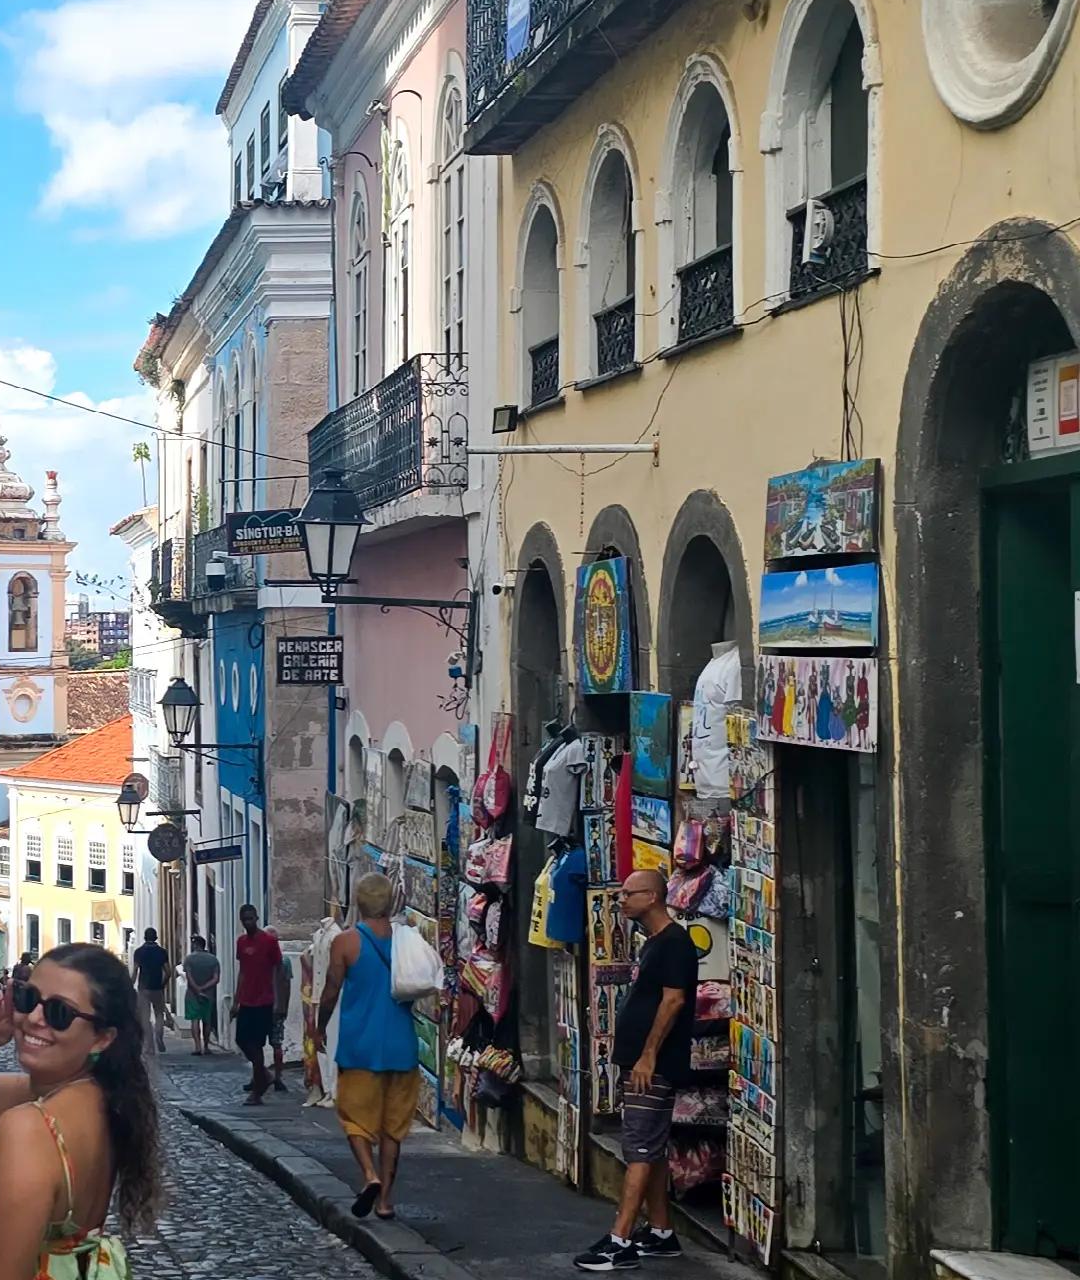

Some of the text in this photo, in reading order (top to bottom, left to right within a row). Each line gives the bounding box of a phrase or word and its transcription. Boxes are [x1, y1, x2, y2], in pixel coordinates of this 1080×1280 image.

[278, 640, 343, 653] RENASCER
[283, 654, 338, 668] GALERIA
[282, 669, 339, 681] DE ARTE
